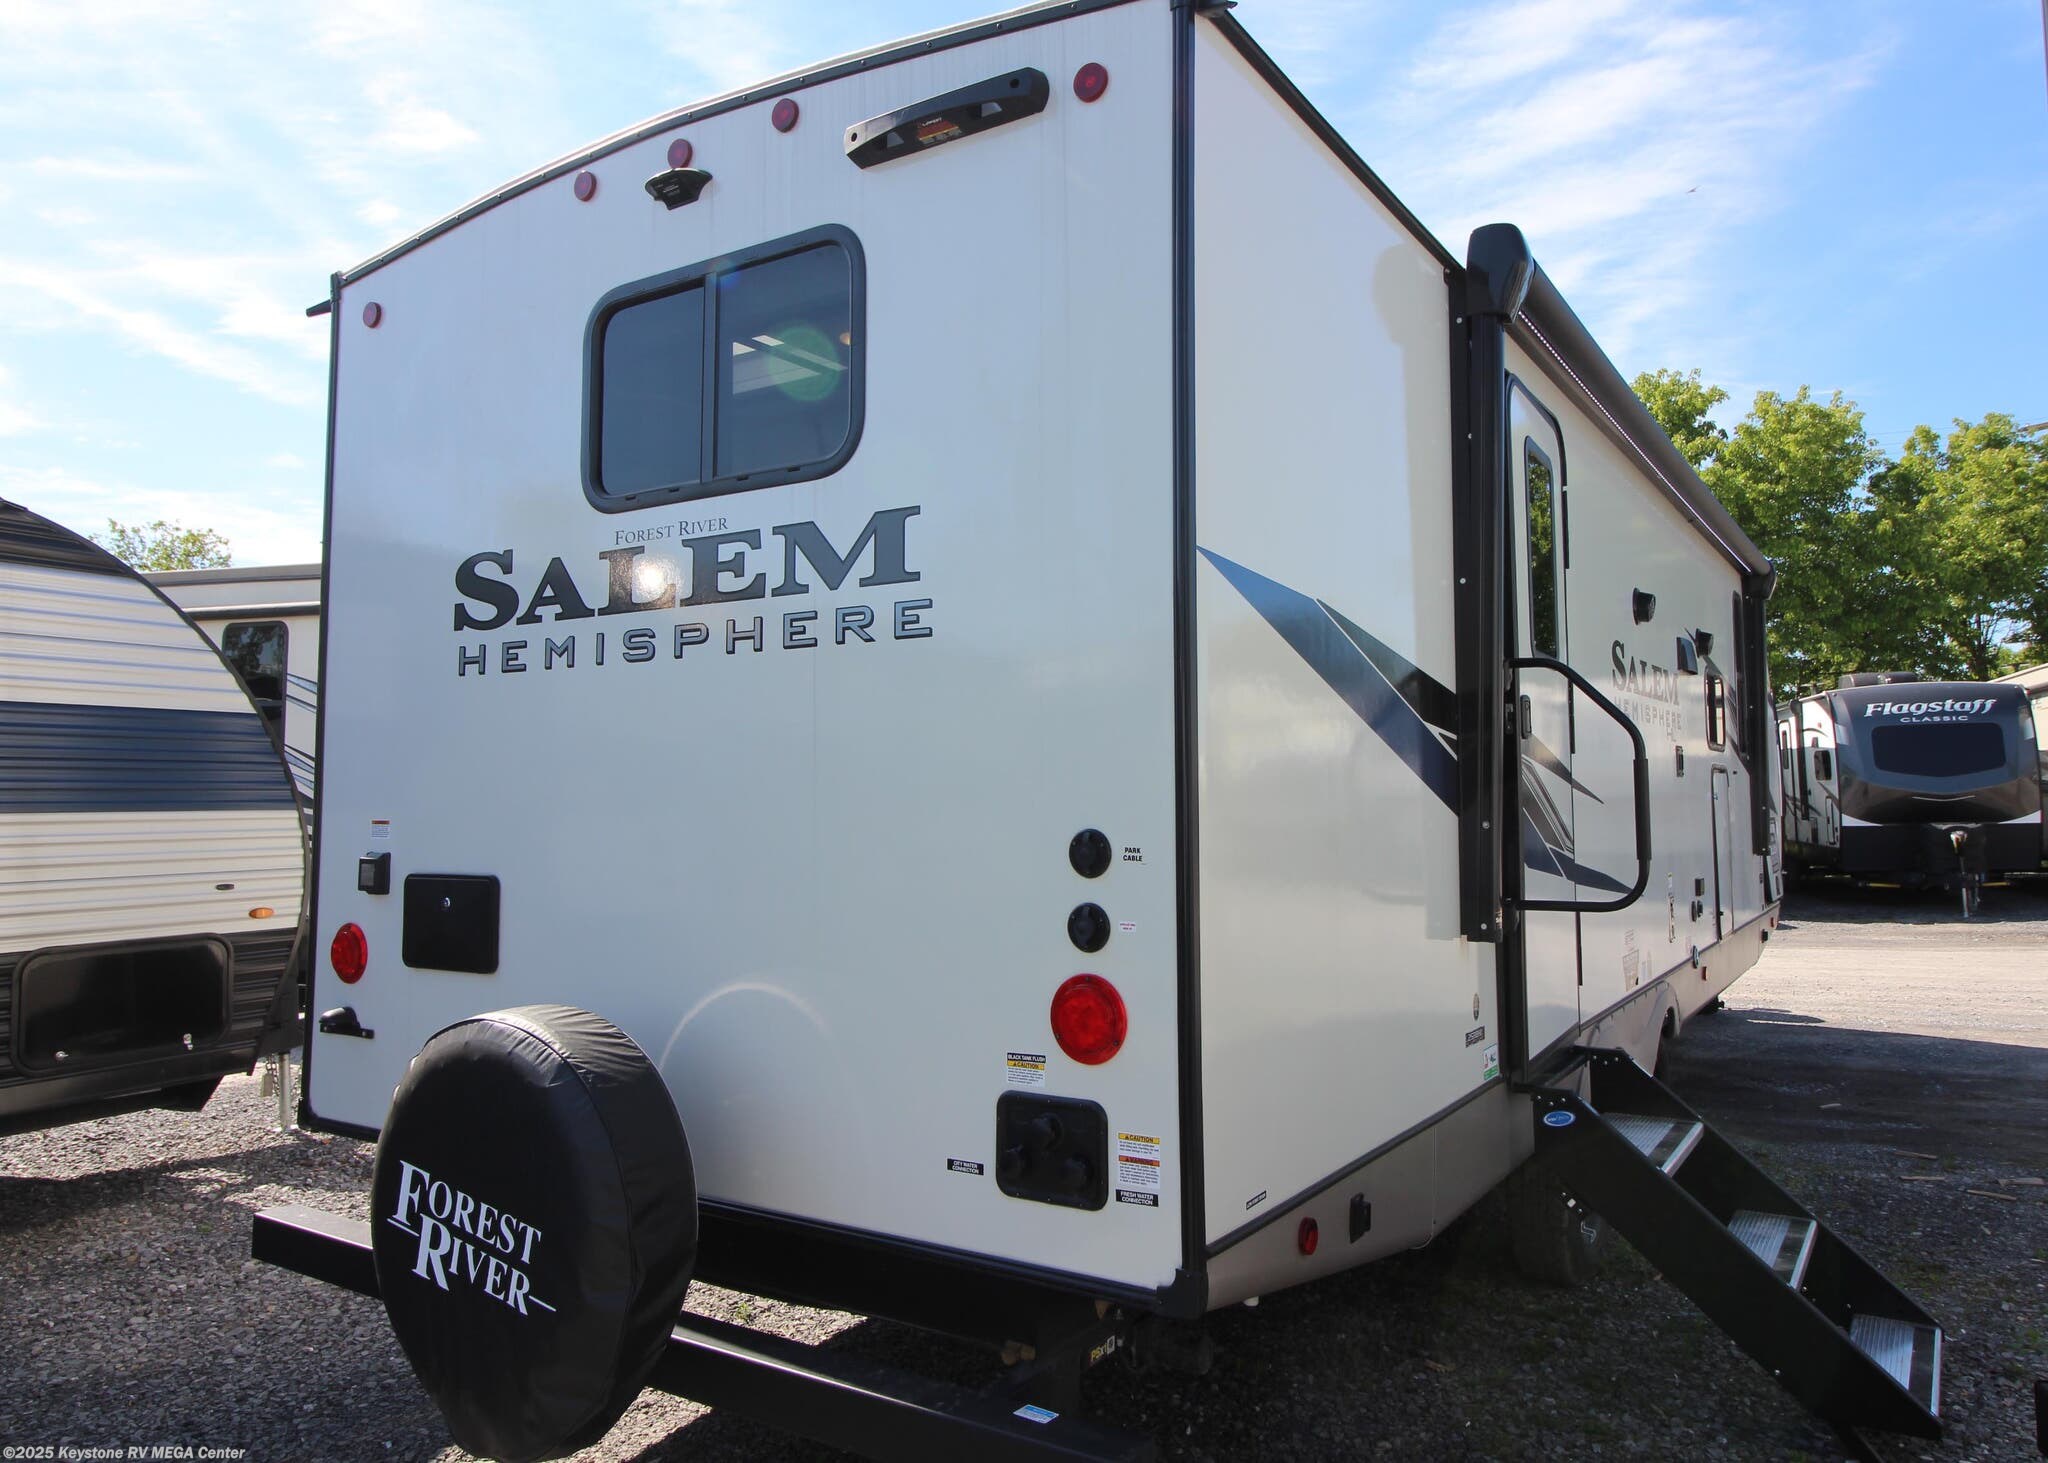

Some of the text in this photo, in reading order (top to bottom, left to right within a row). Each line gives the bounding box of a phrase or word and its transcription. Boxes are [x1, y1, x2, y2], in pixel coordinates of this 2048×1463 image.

[615, 517, 729, 546] FOREST RIVER
[453, 505, 921, 631] SALEM
[458, 598, 933, 676] HEMISPHERE
[1611, 639, 1680, 706] SALEM
[1864, 698, 1998, 717] Flagstaff
[1900, 715, 1969, 723] CLASSIC
[1129, 1134, 1154, 1143] CAUTION
[392, 1159, 542, 1265] FOREST
[411, 1213, 531, 1316] RIVER
